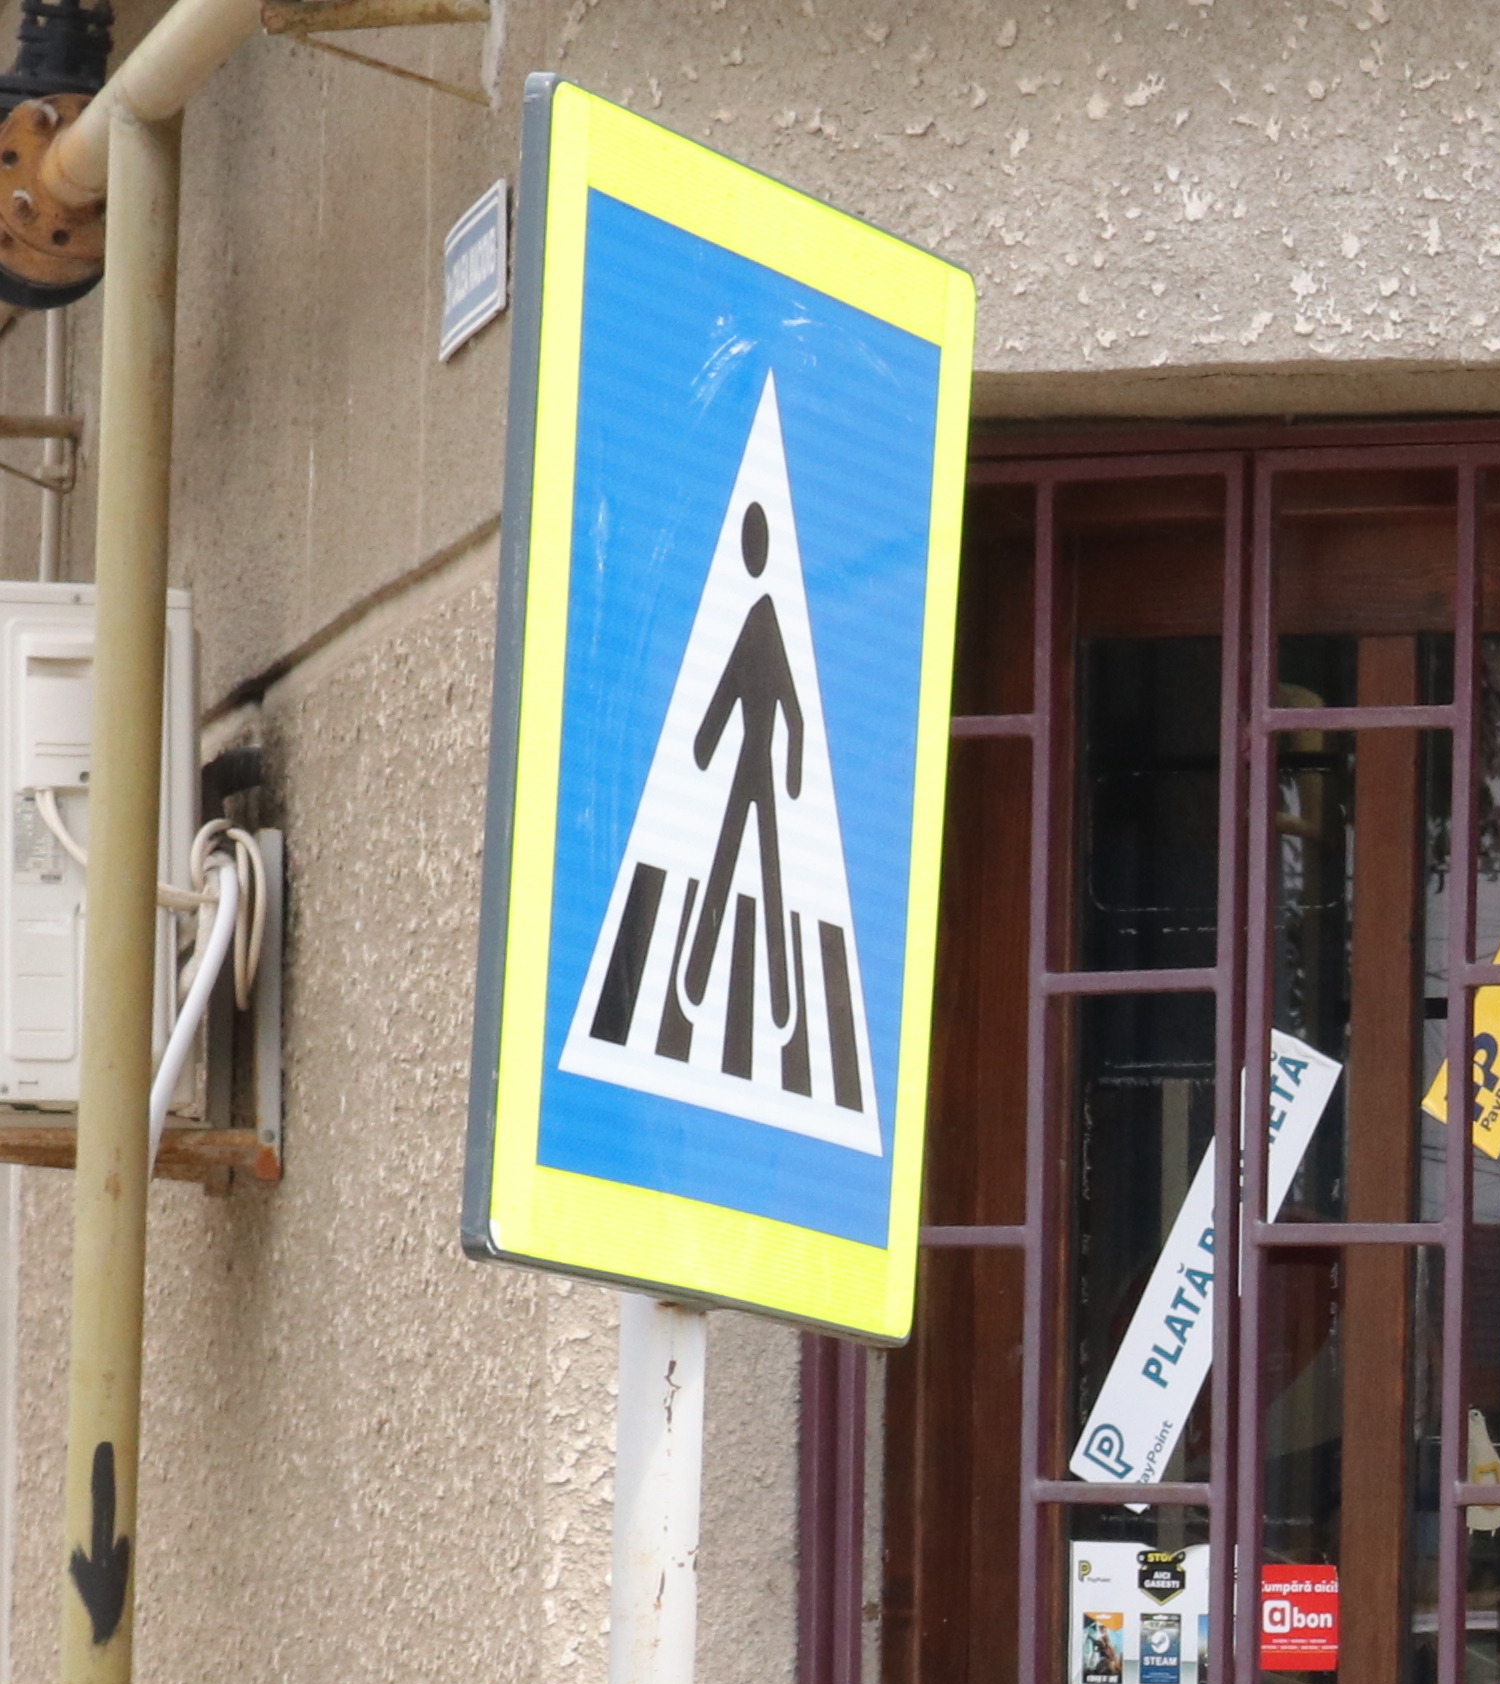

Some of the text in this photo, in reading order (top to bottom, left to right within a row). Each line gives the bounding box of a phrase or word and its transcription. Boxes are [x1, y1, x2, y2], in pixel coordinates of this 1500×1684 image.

[1142, 1263, 1214, 1389] PLATĂ
[1138, 1419, 1174, 1484] ayPoint
[1142, 1656, 1178, 1667] STEAM
